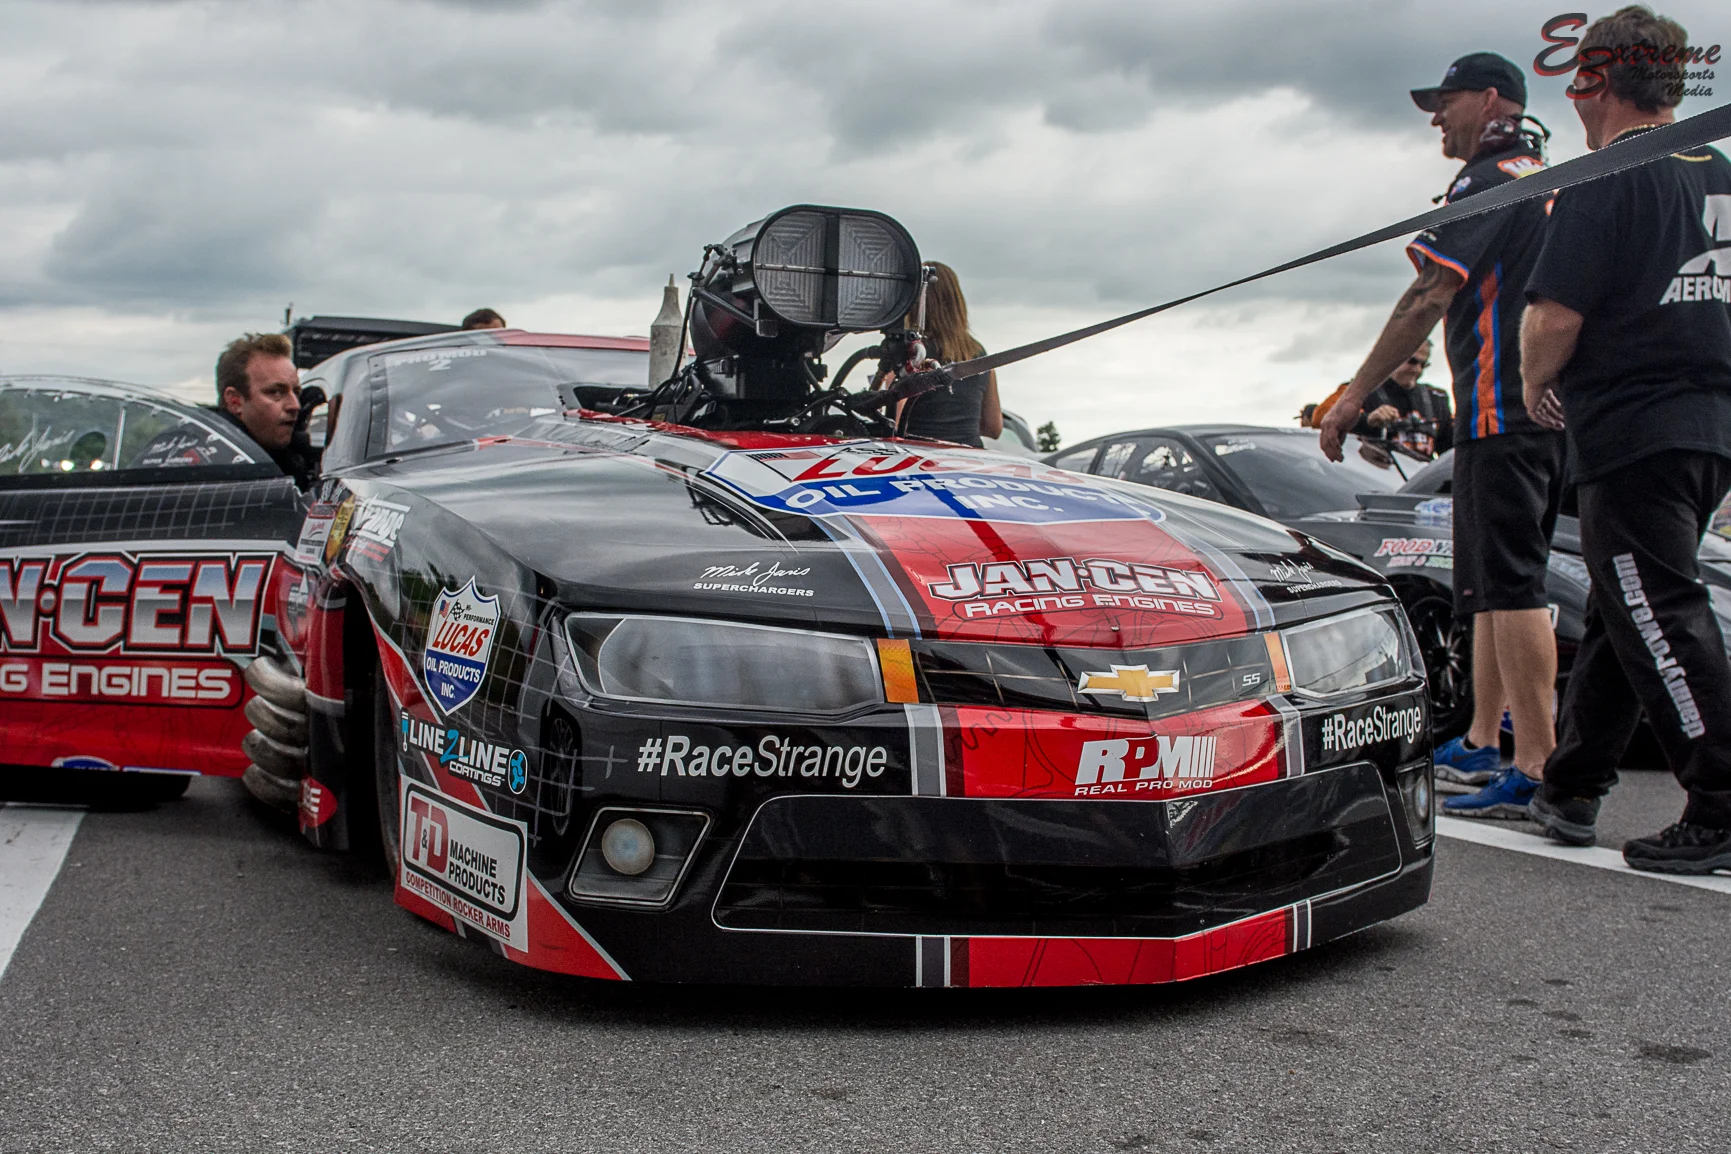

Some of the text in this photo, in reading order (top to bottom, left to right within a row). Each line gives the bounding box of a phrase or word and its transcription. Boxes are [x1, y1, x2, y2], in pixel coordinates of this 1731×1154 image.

[791, 454, 1086, 484] LUCAS
[785, 483, 881, 509] OIL
[953, 493, 1065, 513] INC.
[693, 582, 815, 597] SUPERCHARGERS
[1286, 579, 1342, 594] SUPERCHARGERS
[965, 594, 1215, 618] RACING ENGINES
[463, 613, 495, 626] PERFORMANCE
[432, 620, 491, 658] LUCAS
[41, 662, 232, 700] ENGINES
[426, 656, 481, 683] OIL PRODUCTS
[1242, 672, 1261, 686] SS
[1321, 705, 1422, 752] #RaceStrange
[449, 761, 503, 787] COATINGS
[637, 735, 888, 788] #RaceStrange
[1074, 779, 1213, 797] REAL PRO MOD
[450, 839, 498, 879] MACHINE
[449, 861, 506, 906] PRODUCTS
[406, 871, 511, 939] COMPETITION ROCKER ARMS
